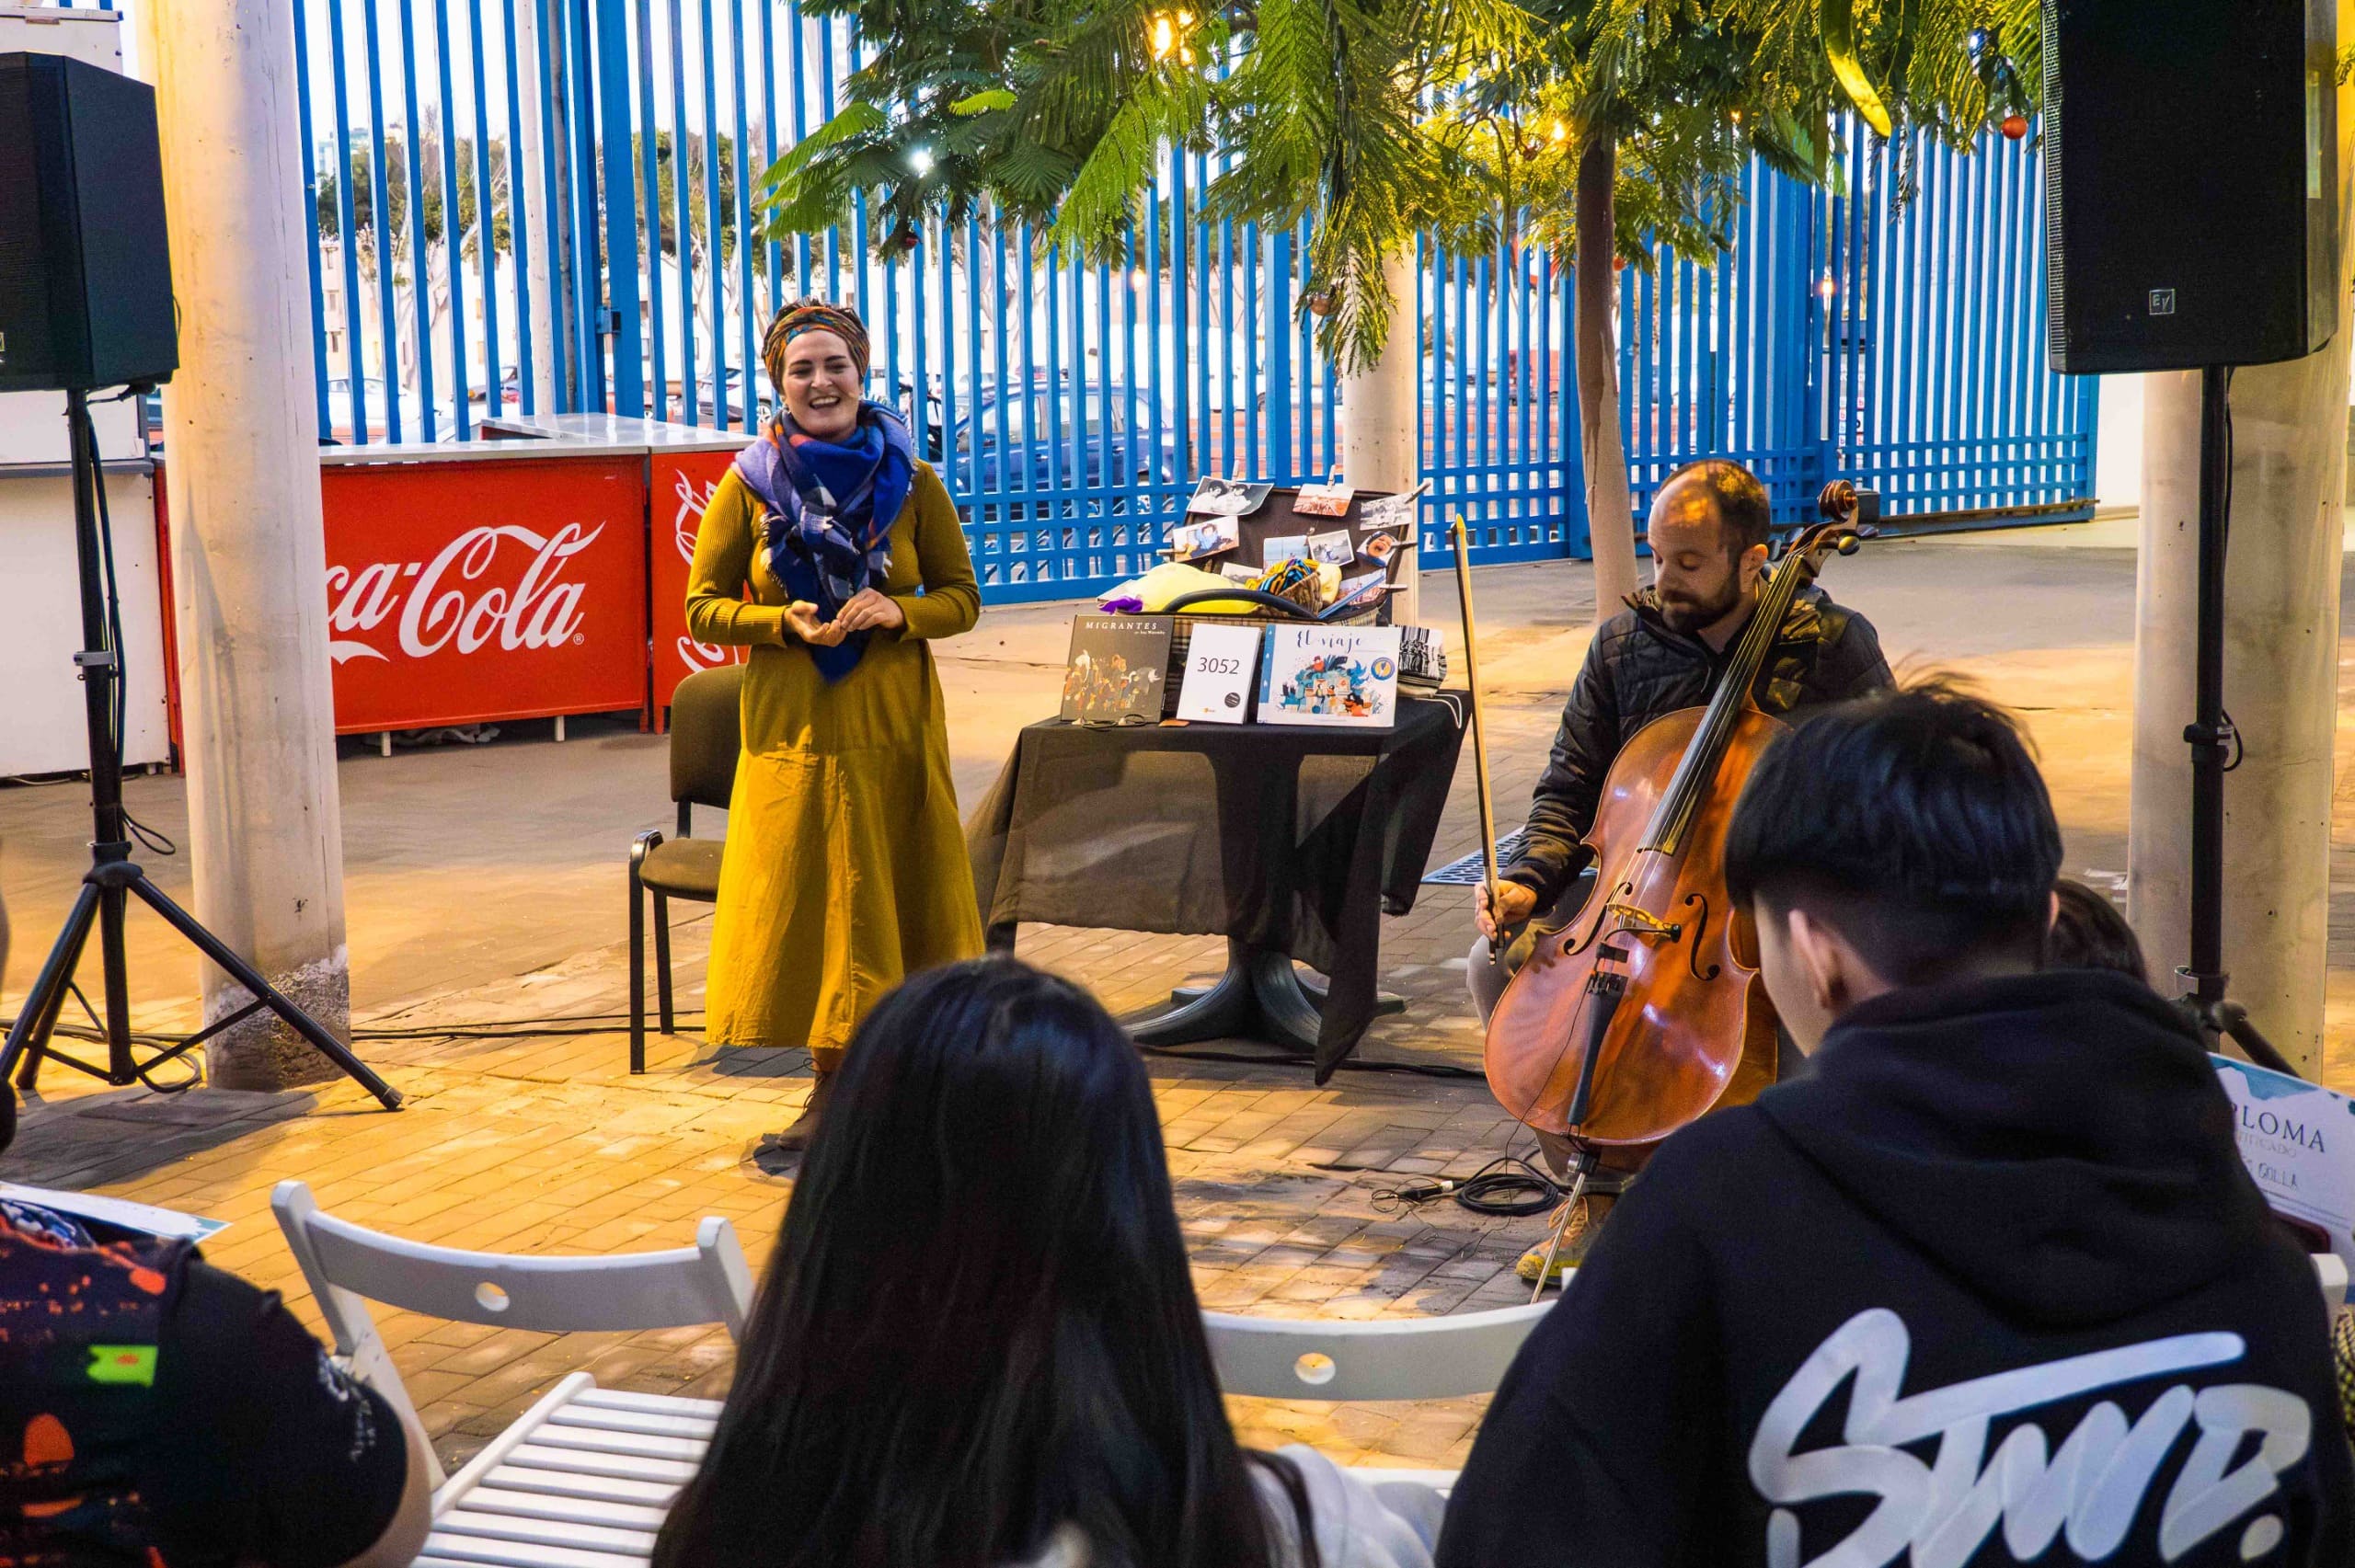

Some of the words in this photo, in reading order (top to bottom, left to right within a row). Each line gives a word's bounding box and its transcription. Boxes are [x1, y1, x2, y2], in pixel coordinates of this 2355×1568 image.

[325, 521, 606, 664] ca-Cola
[1086, 622, 1157, 630] MIGRANTES
[1197, 657, 1240, 675] 3052
[2235, 1104, 2325, 1153] LOMA
